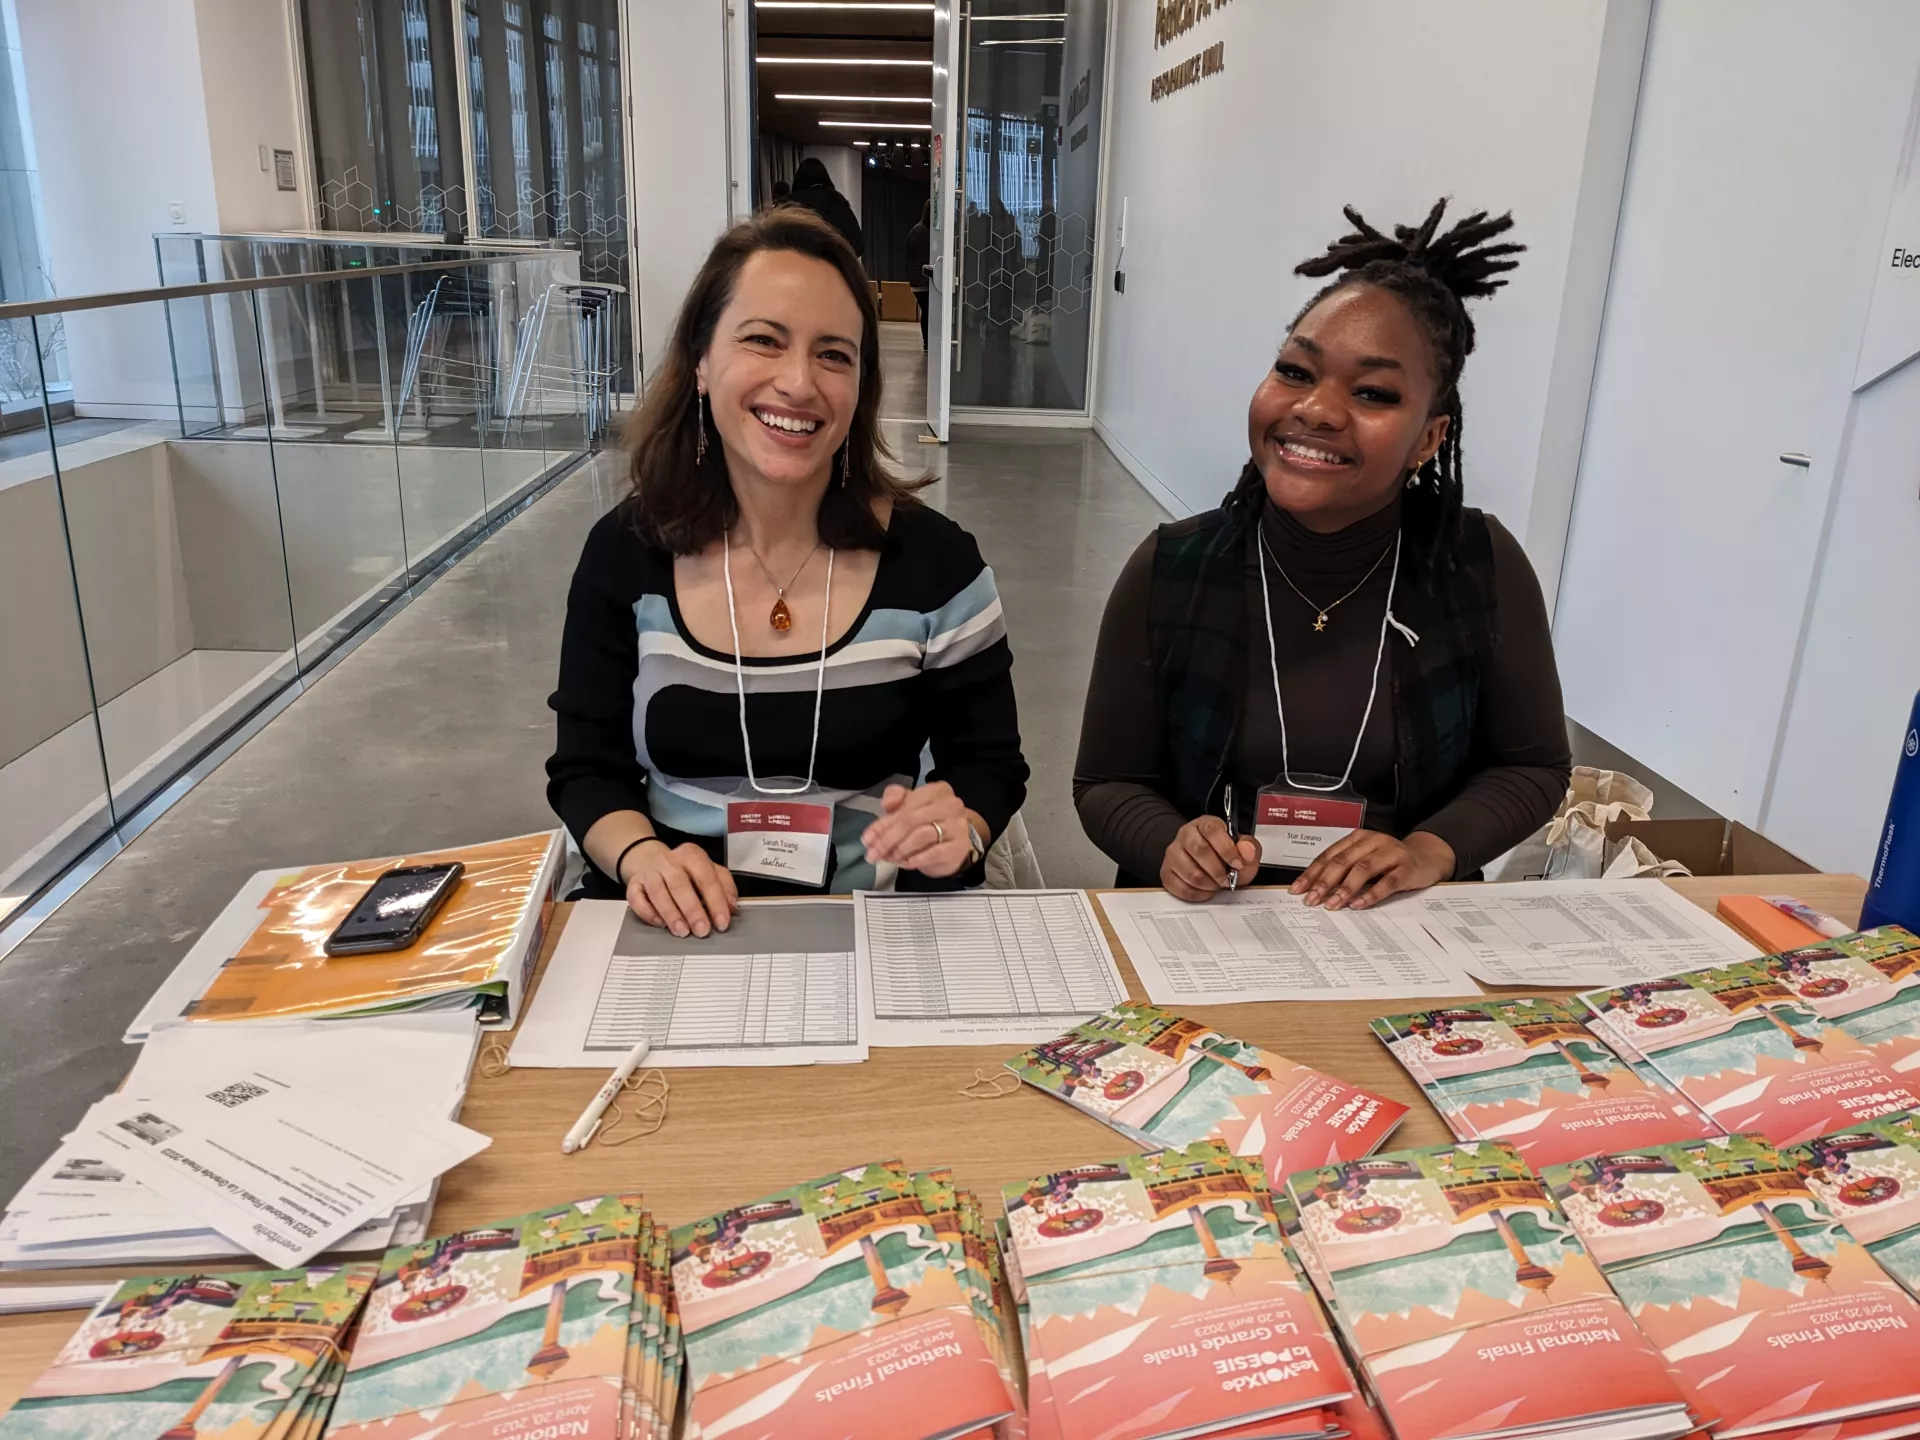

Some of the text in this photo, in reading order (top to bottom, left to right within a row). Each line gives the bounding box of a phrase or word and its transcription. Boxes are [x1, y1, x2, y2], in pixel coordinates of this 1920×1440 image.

[1891, 248, 1920, 269] Elec
[763, 838, 798, 851] Sarah Tsiang
[1874, 823, 1896, 888] ThermoFlask
[1329, 1085, 1346, 1095] La
[1778, 1075, 1893, 1105] La Grande finale
[1303, 1093, 1336, 1119] Grande
[1281, 1118, 1311, 1142] finale
[1561, 1111, 1667, 1131] National Finals
[200, 1169, 229, 1187] Grande
[241, 1190, 266, 1210] Finals
[261, 1204, 297, 1226] National
[252, 1224, 302, 1253] eventbrite
[292, 1222, 318, 1239] 2023
[1257, 1313, 1274, 1324] 20
[1275, 1311, 1291, 1320] Le
[1809, 1310, 1842, 1324] 2023
[1840, 1308, 1860, 1319] 20,
[1861, 1303, 1893, 1316] April
[1194, 1322, 1227, 1337] 2023
[1228, 1316, 1254, 1330] avril
[1523, 1322, 1556, 1335] 2023
[1556, 1320, 1577, 1330] 20,
[1577, 1315, 1609, 1328] April
[922, 1330, 955, 1347] April
[1766, 1315, 1909, 1349] National Finals
[900, 1340, 920, 1353] 20,
[1142, 1322, 1299, 1366] La Grande finale
[1476, 1328, 1621, 1362] National Finals
[867, 1348, 900, 1366] 2023
[877, 1342, 963, 1381] National
[815, 1371, 874, 1403] Finals
[556, 1403, 592, 1420] April
[492, 1417, 529, 1435] 2023
